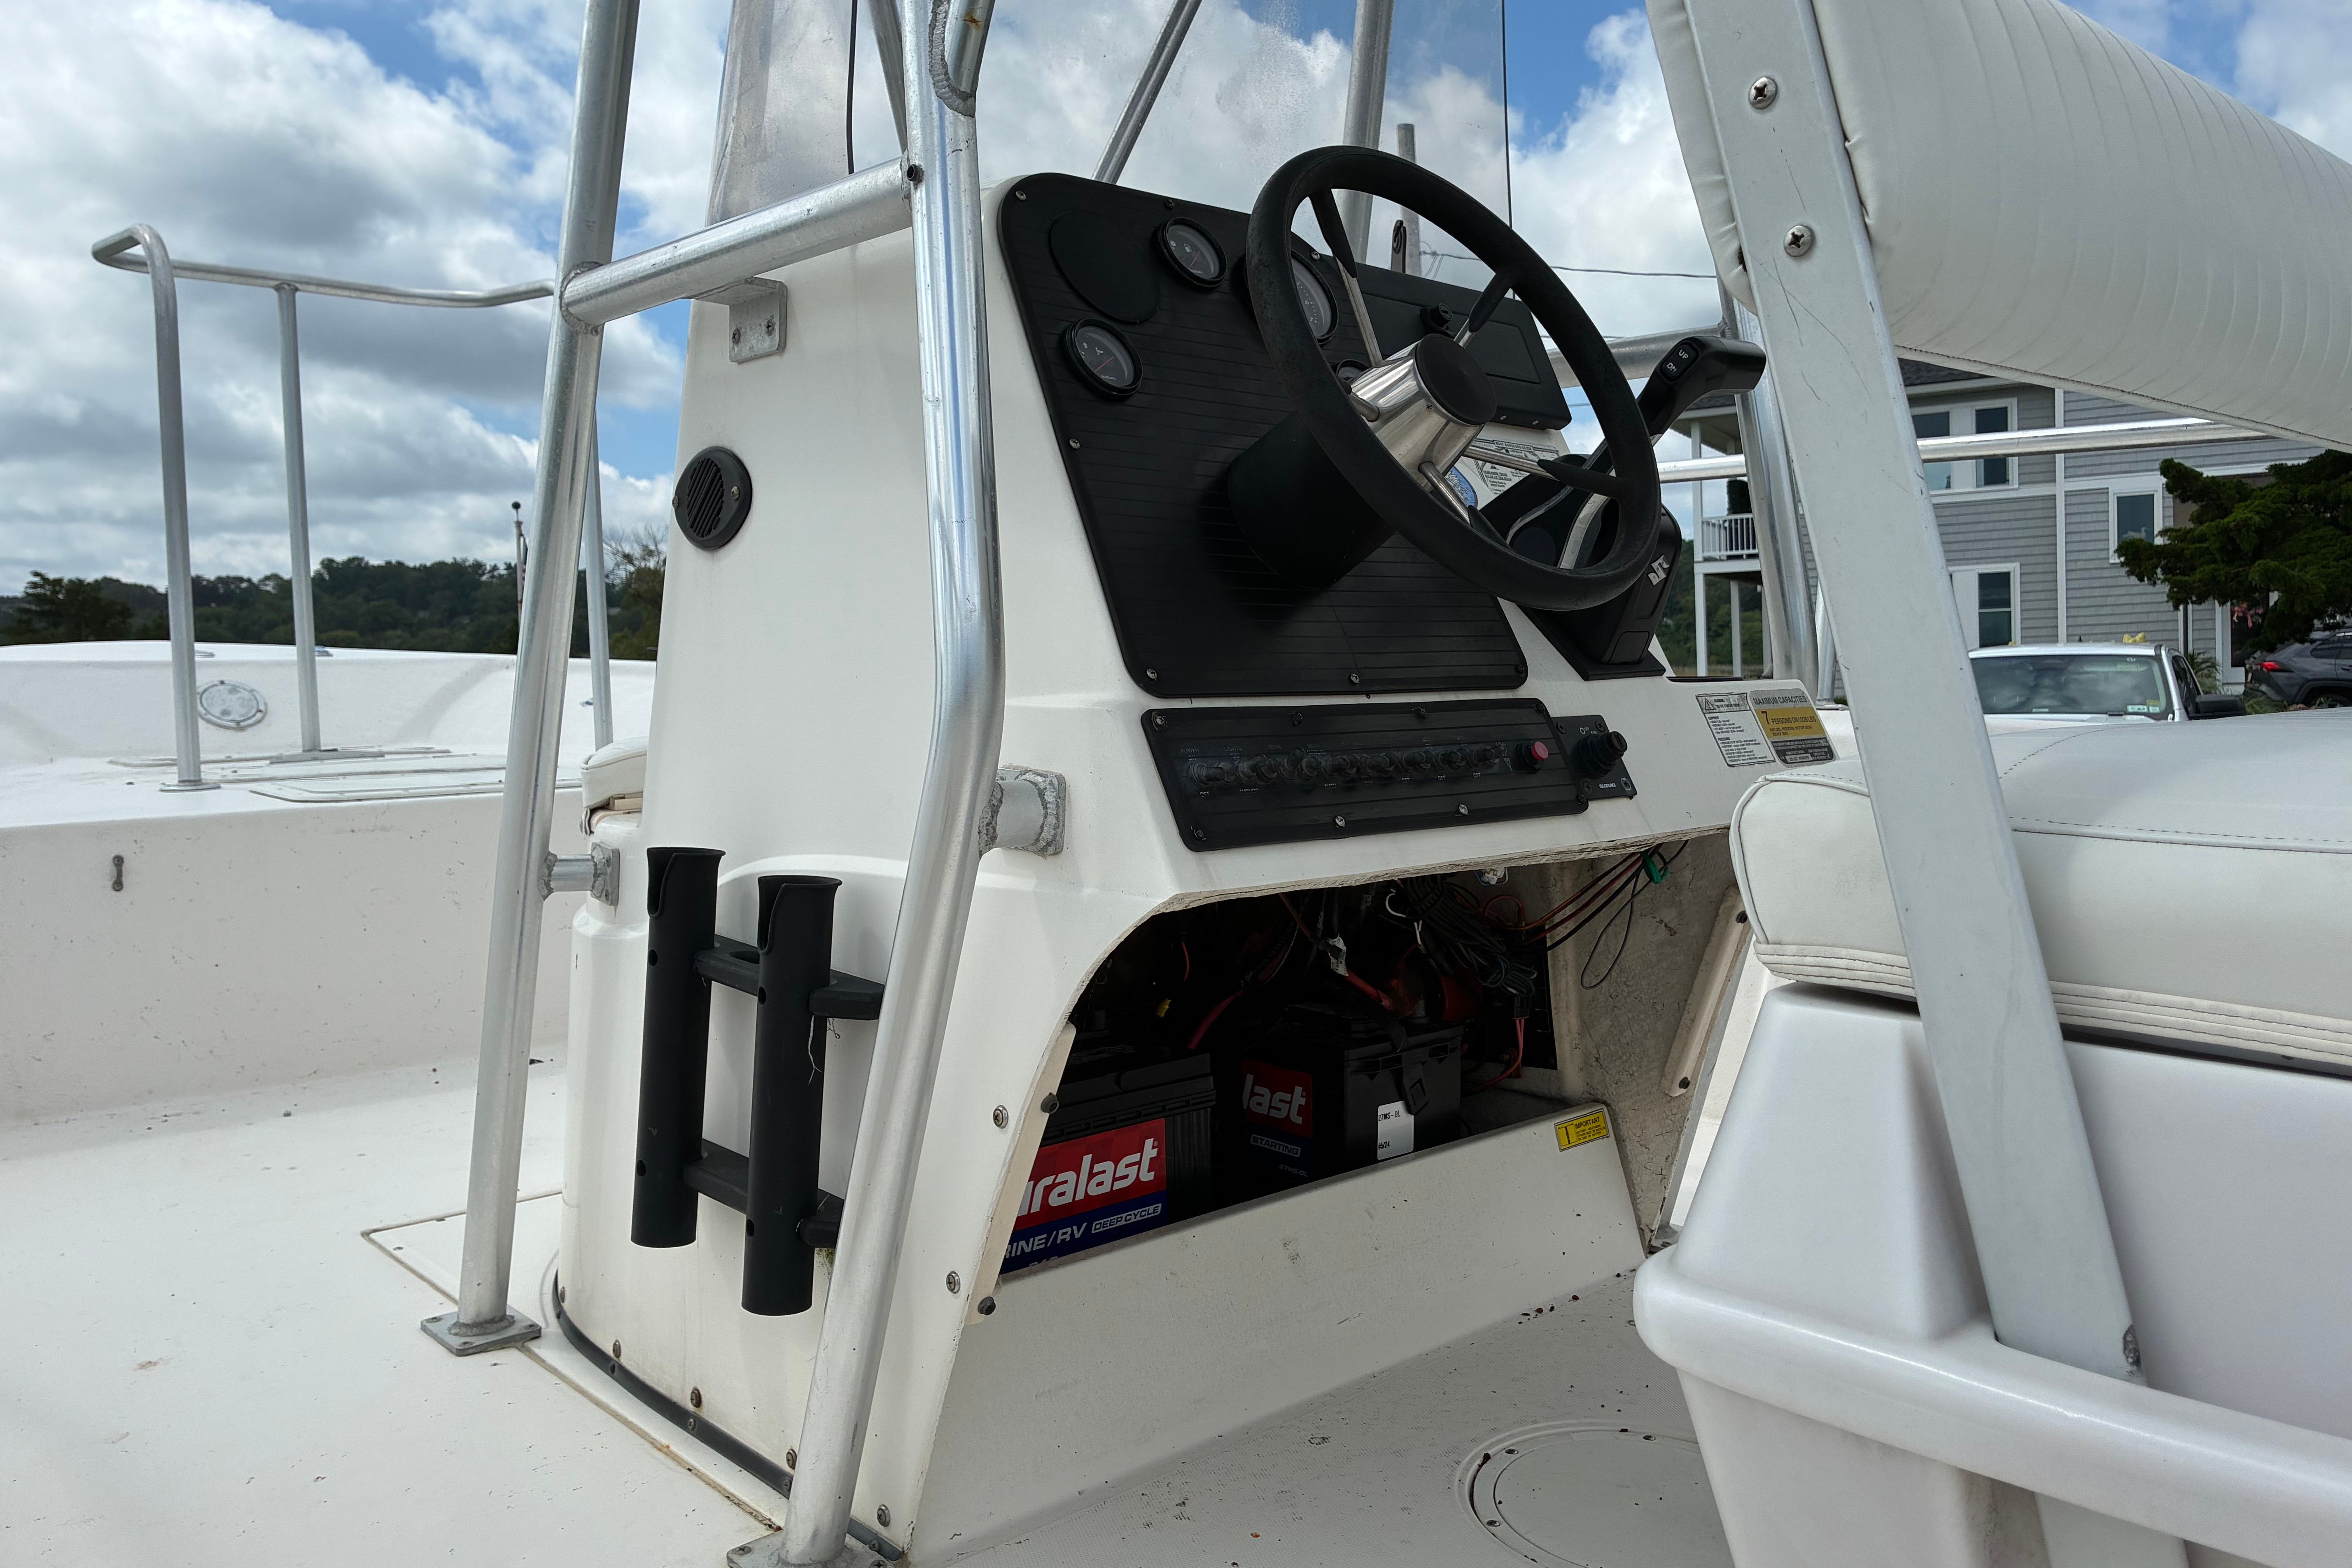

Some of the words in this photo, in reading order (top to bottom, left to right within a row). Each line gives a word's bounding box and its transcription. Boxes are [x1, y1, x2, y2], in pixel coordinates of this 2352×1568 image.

[1678, 349, 1689, 359] UP
[1666, 362, 1677, 372] DN
[1778, 695, 1808, 704] CAPACITIES
[1761, 711, 1769, 725] 7
[1575, 1116, 1600, 1129] IMPORTANT
[1251, 1135, 1299, 1156] STARTING
[1093, 1216, 1123, 1232] DEEP
[1124, 1205, 1160, 1222] CYCLE
